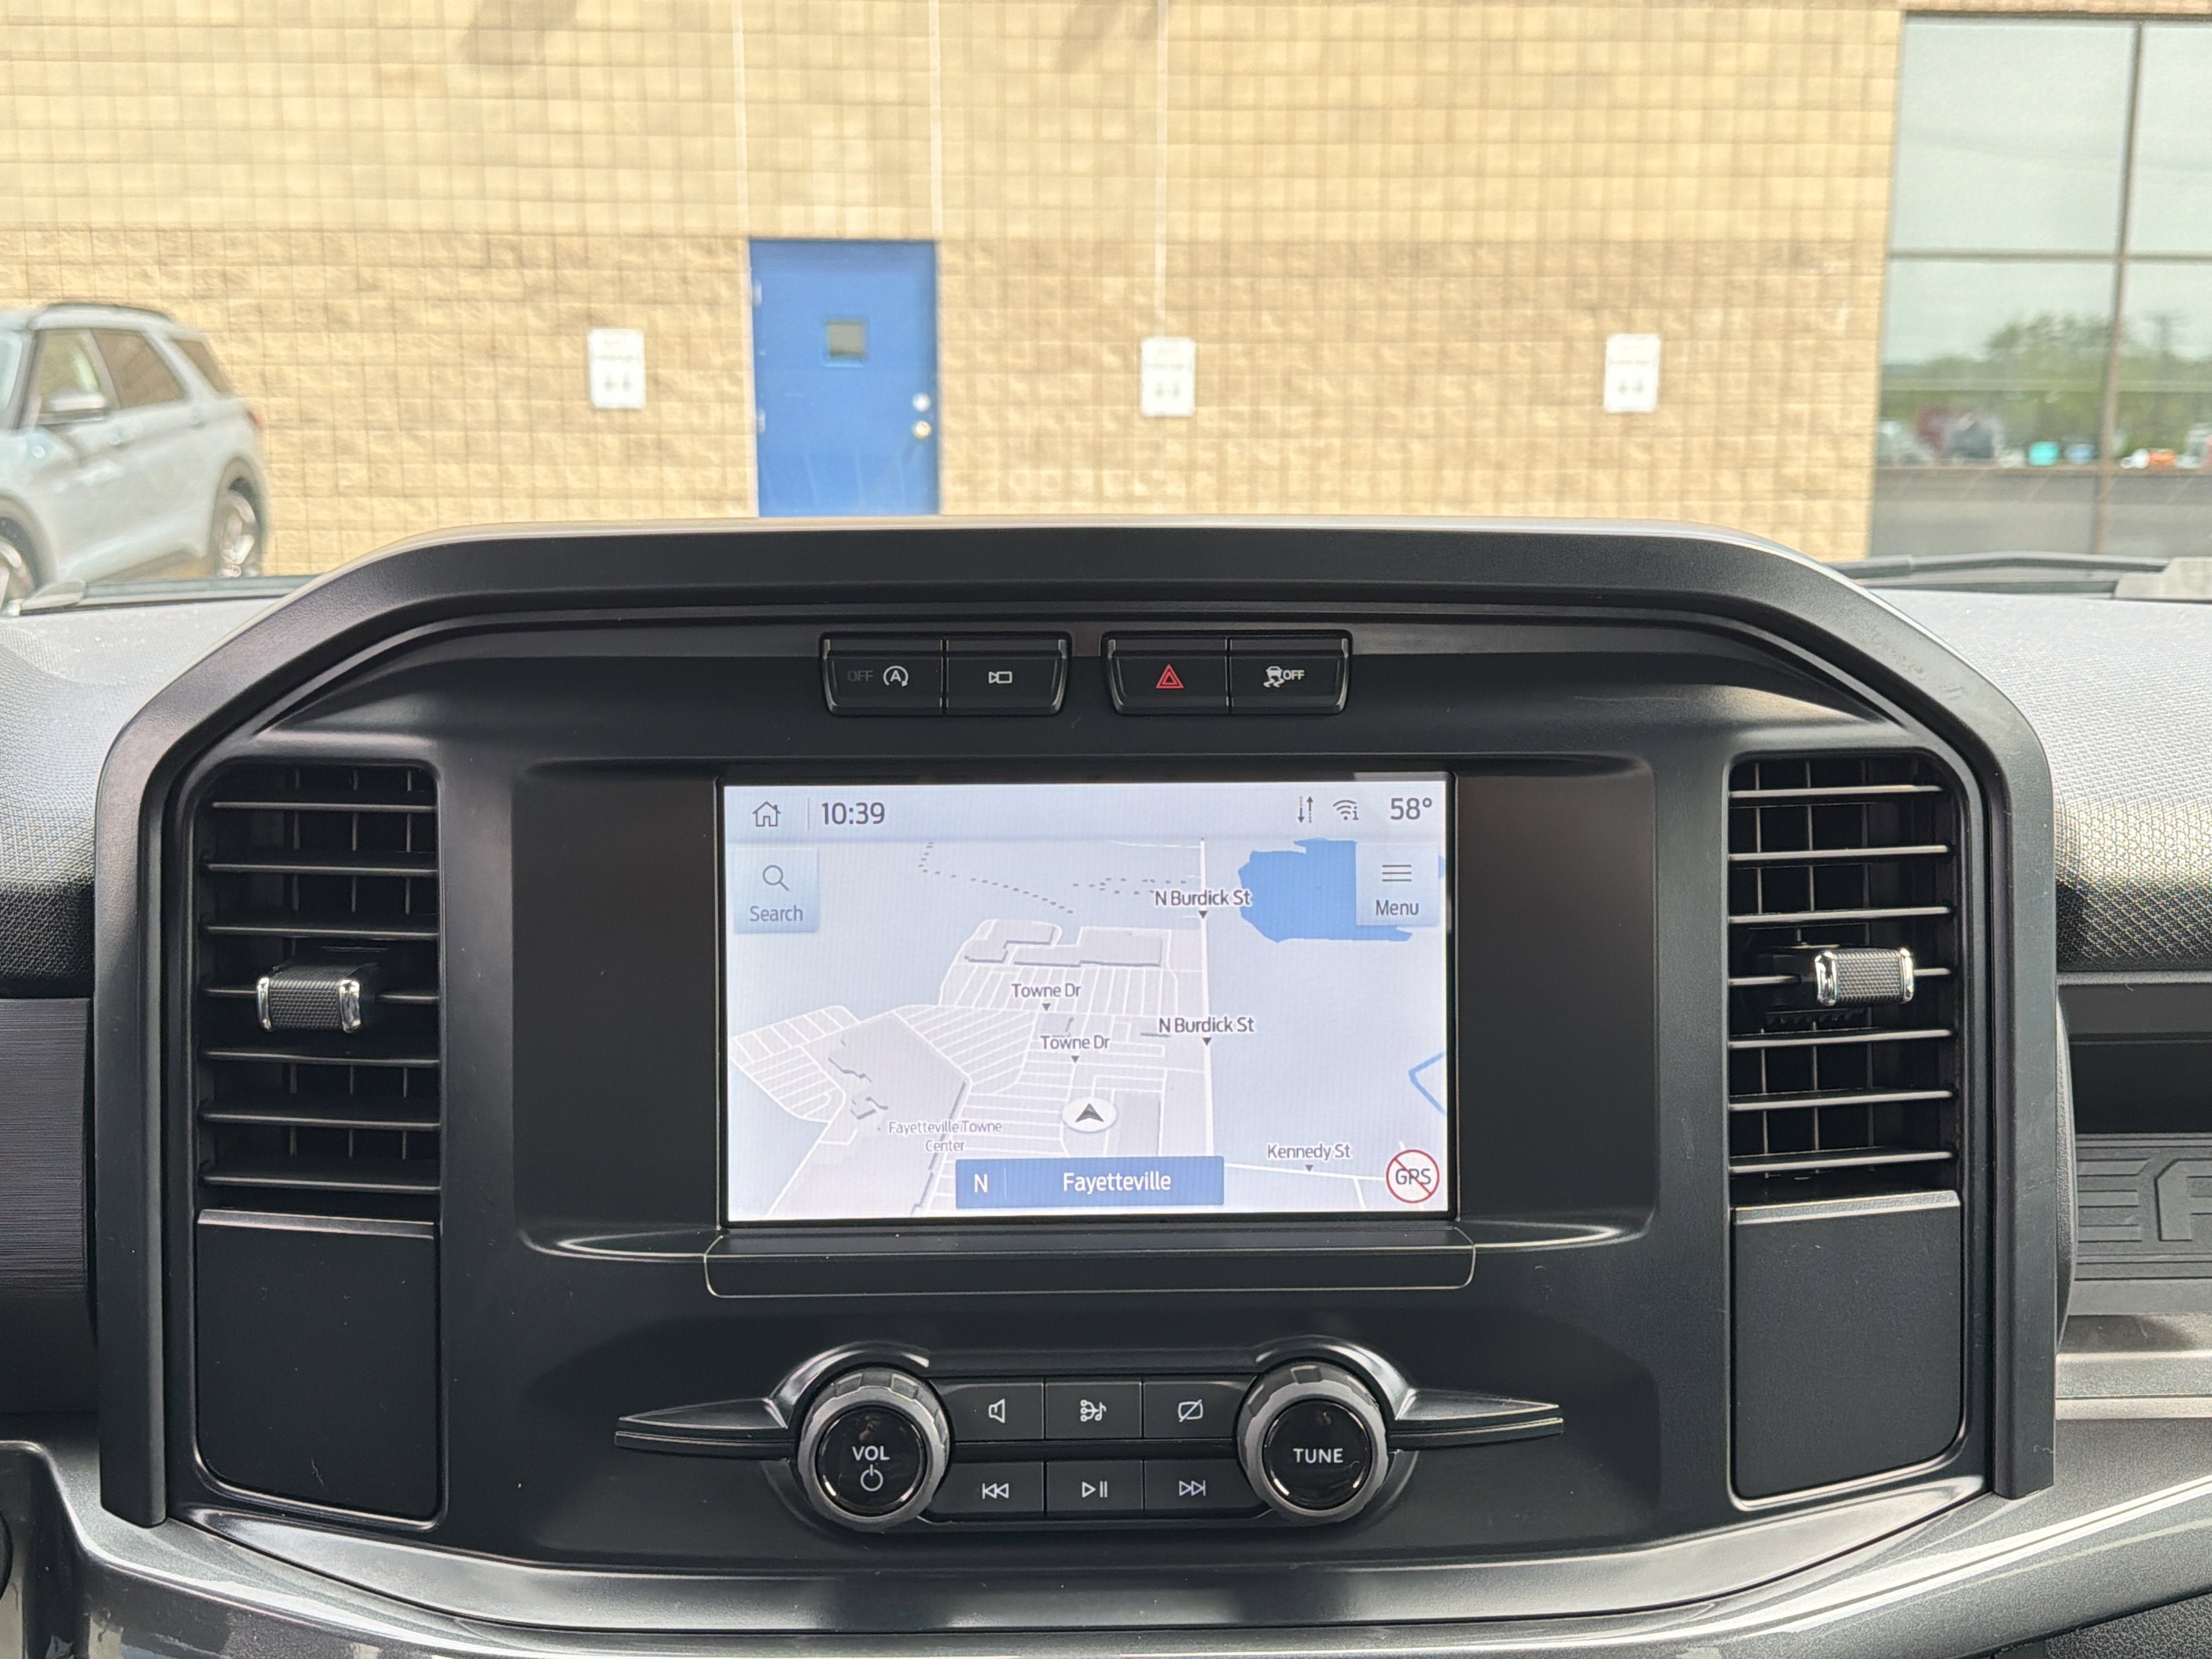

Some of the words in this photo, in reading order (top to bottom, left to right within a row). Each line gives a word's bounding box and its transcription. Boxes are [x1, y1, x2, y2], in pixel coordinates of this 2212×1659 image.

[847, 670, 874, 682] OFF
[1283, 669, 1305, 680] OFF
[821, 802, 885, 825] 10:39
[1390, 797, 1433, 821] 58°
[1155, 890, 1167, 906] N
[1170, 889, 1229, 906] Burdick
[1233, 890, 1251, 906] St
[749, 904, 804, 922] Search
[1375, 899, 1419, 916] Menu
[1011, 983, 1062, 998] Towne
[1064, 983, 1081, 998] Dr
[1159, 1017, 1171, 1033] N
[1174, 1016, 1233, 1033] Burdick
[1236, 1017, 1255, 1032] St
[1040, 1035, 1091, 1050] Towne
[1093, 1035, 1110, 1049] Dr
[889, 1120, 960, 1136] Fayetteville
[961, 1120, 1003, 1133] Towne
[925, 1139, 966, 1152] Center
[1267, 1144, 1331, 1161] Kennedy
[1334, 1144, 1351, 1158] St
[974, 1173, 989, 1193] N
[1063, 1171, 1172, 1195] Fayetteville
[1395, 1167, 1432, 1186] GPS
[851, 1445, 890, 1462] VOL
[1292, 1447, 1344, 1464] TUNE
